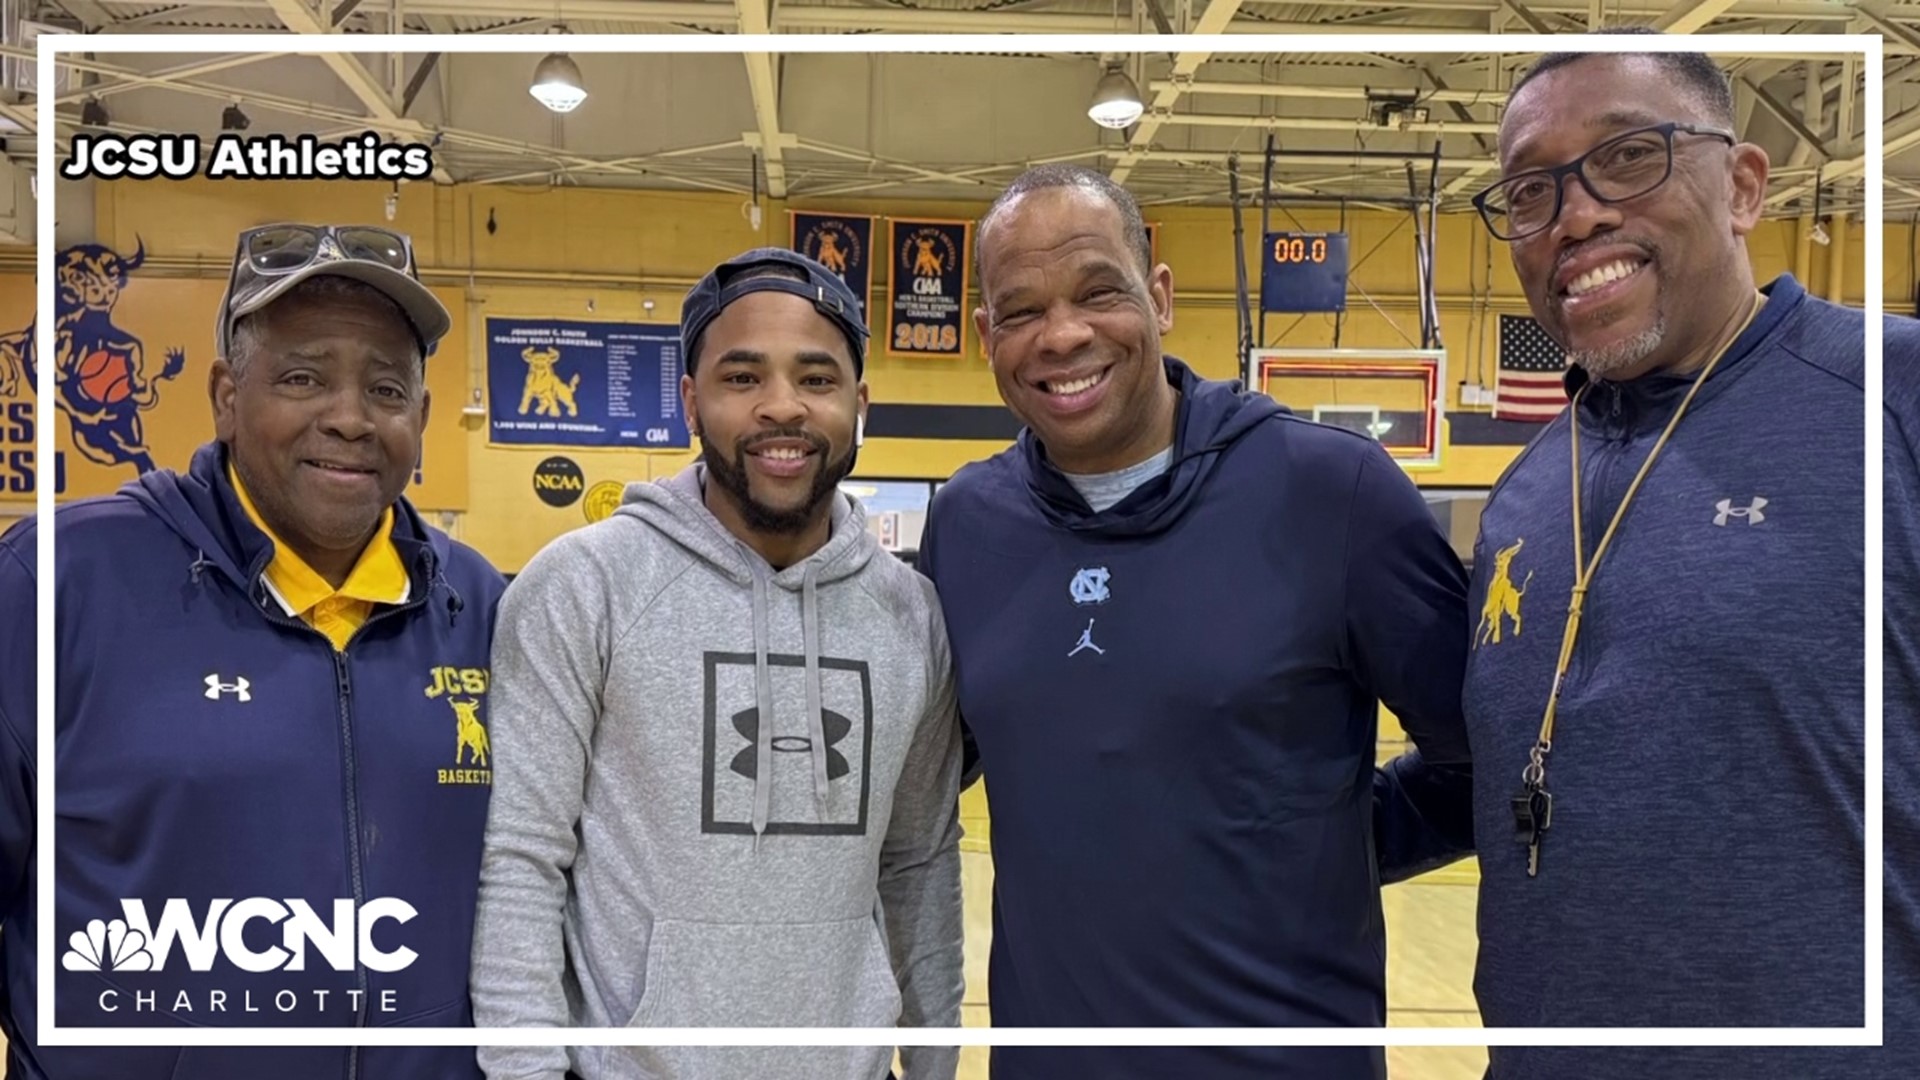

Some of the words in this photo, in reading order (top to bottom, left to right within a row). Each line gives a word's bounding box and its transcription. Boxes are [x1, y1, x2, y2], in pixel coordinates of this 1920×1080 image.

[1274, 238, 1327, 263] 00.0
[912, 277, 942, 295] CIAA
[895, 322, 957, 351] 2018
[535, 473, 582, 490] NCAA
[424, 665, 490, 699] JCS
